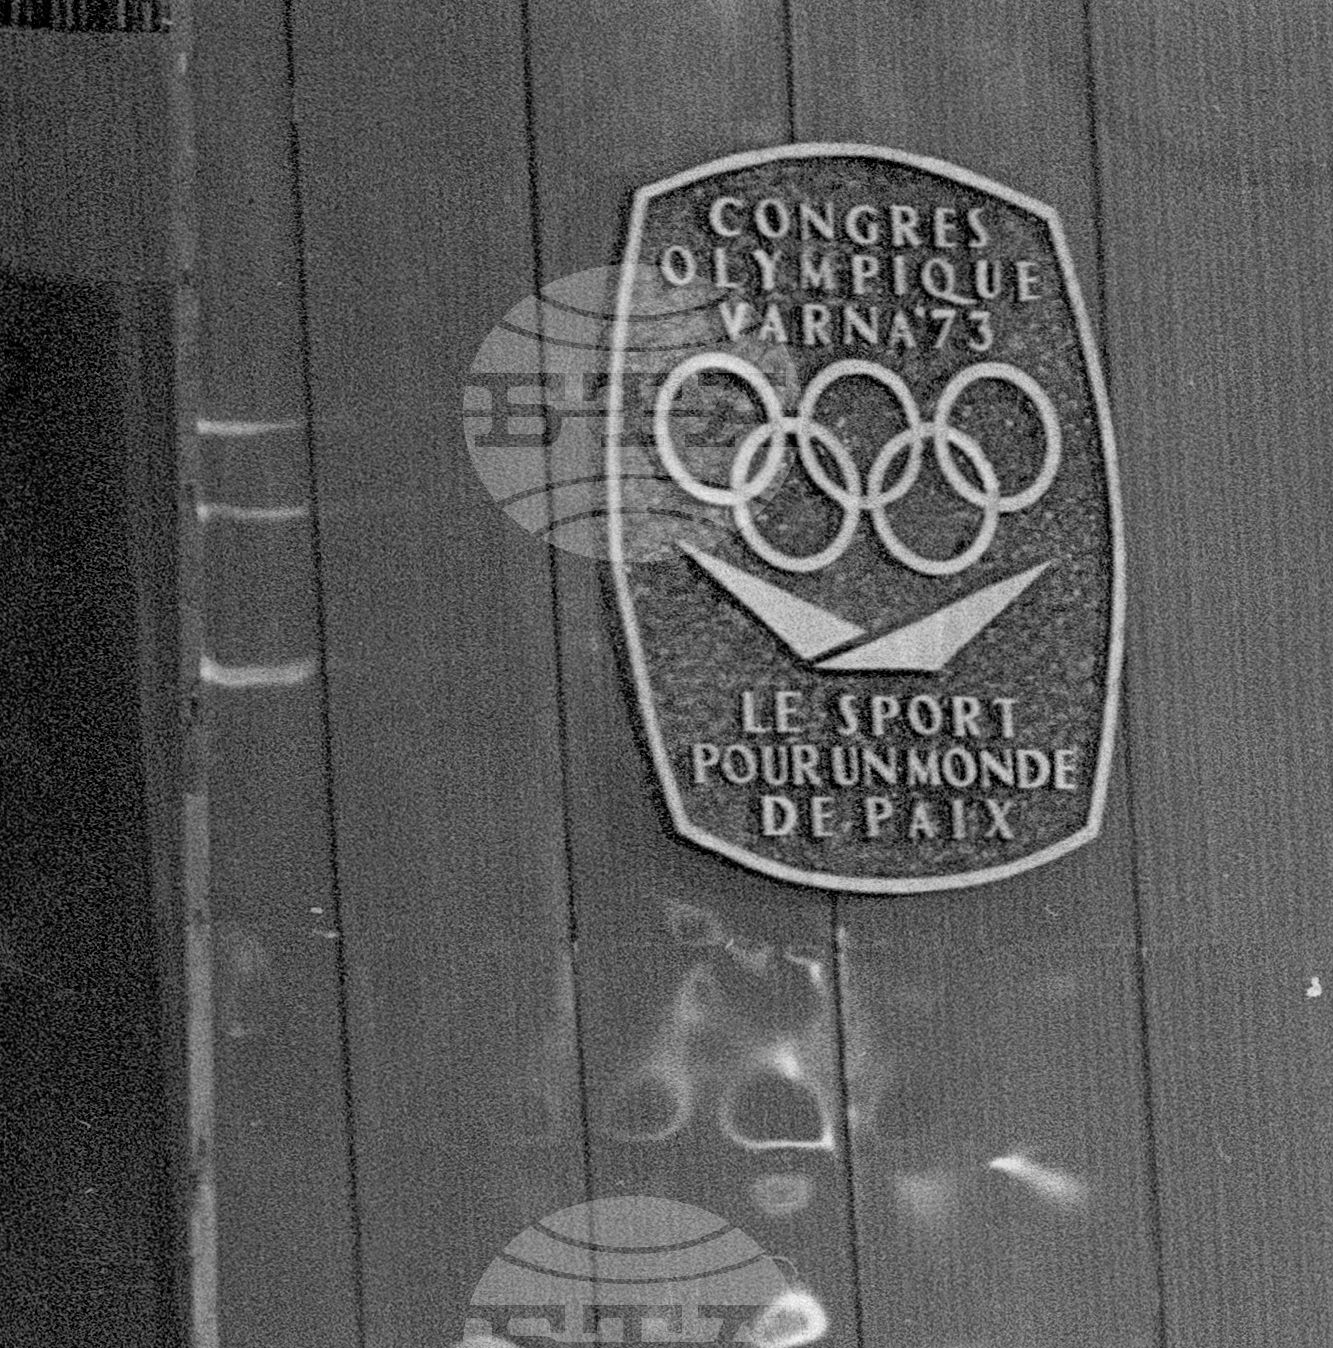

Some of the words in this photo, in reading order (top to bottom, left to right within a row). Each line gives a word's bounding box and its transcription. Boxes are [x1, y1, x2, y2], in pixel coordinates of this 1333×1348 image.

[708, 196, 988, 249] CONGRES
[659, 243, 1044, 305] OLYMPIQUE
[742, 691, 801, 734] LE
[838, 694, 1018, 740] SPORT
[692, 742, 822, 787] POUR
[831, 745, 898, 788] UN
[907, 747, 1077, 791] MONDE
[762, 795, 835, 838] DE
[866, 797, 1015, 841] PAIX
